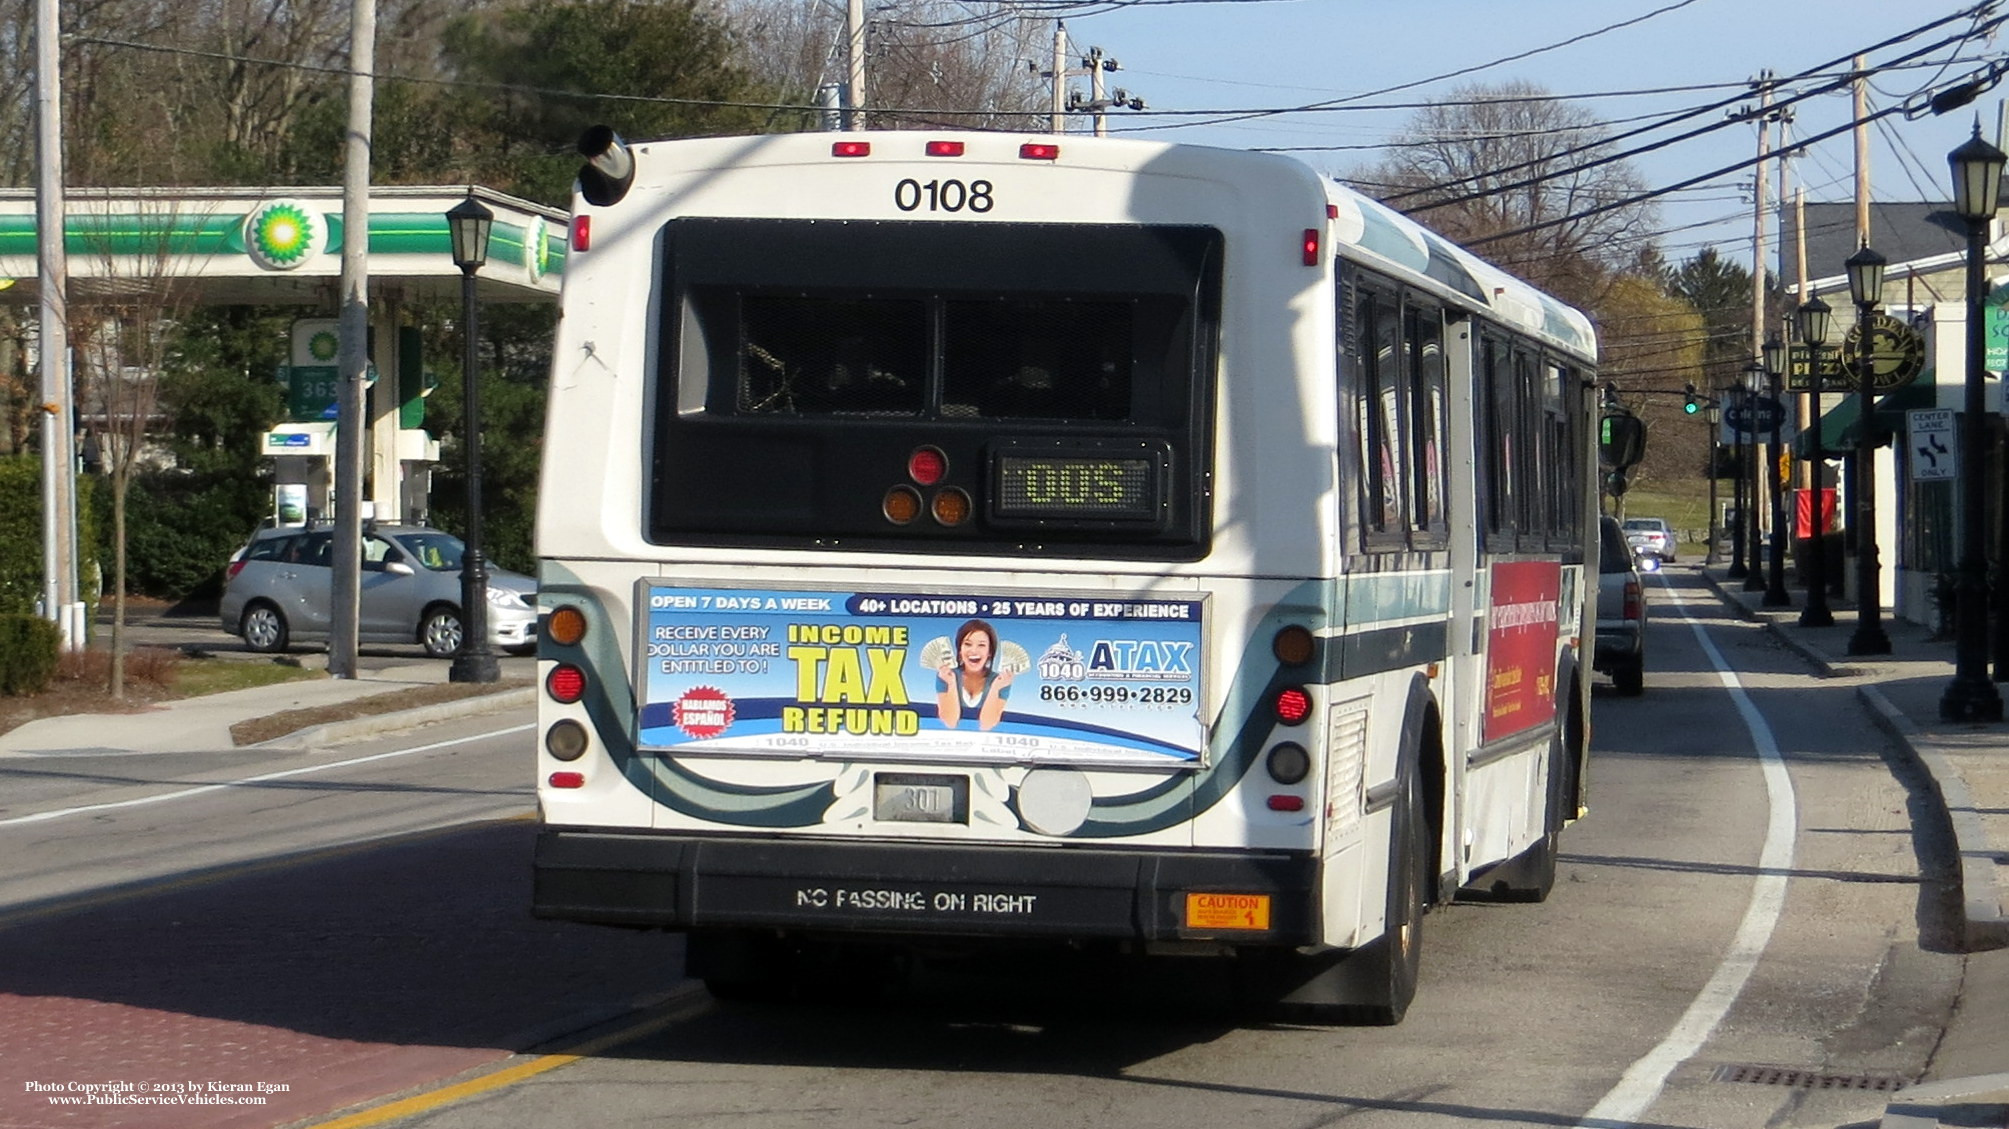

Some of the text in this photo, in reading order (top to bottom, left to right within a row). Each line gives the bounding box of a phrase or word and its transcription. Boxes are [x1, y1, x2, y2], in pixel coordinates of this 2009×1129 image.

[895, 178, 994, 213] 0108
[1913, 412, 1949, 422] CENTER
[1919, 421, 1943, 429] LANE
[1921, 468, 1946, 477] ONLY
[651, 596, 831, 611] OPEN 7 DAYS A WEEK
[859, 599, 1189, 618] 40+ LOCATIONS 25 YEARS OF EXPERIENCE
[656, 626, 770, 641] RECEIVE EVERY
[788, 624, 909, 646] INCOME
[648, 643, 780, 657] DOLLAR YOU ARE
[1090, 641, 1191, 673] ATAX
[661, 660, 738, 674] ENTITLED
[1039, 662, 1084, 679] 1040
[788, 646, 910, 706] TAX
[682, 699, 727, 711] HABLAMOS
[683, 711, 725, 726] ESPAÑOL
[782, 706, 919, 736] REFUND
[766, 737, 810, 748] 1040
[995, 735, 1040, 748] 1040
[905, 787, 939, 811] 301
[797, 888, 828, 907] NO
[934, 892, 965, 911] ON
[974, 894, 1037, 913] RIGHT
[1198, 896, 1259, 909] CAUTION
